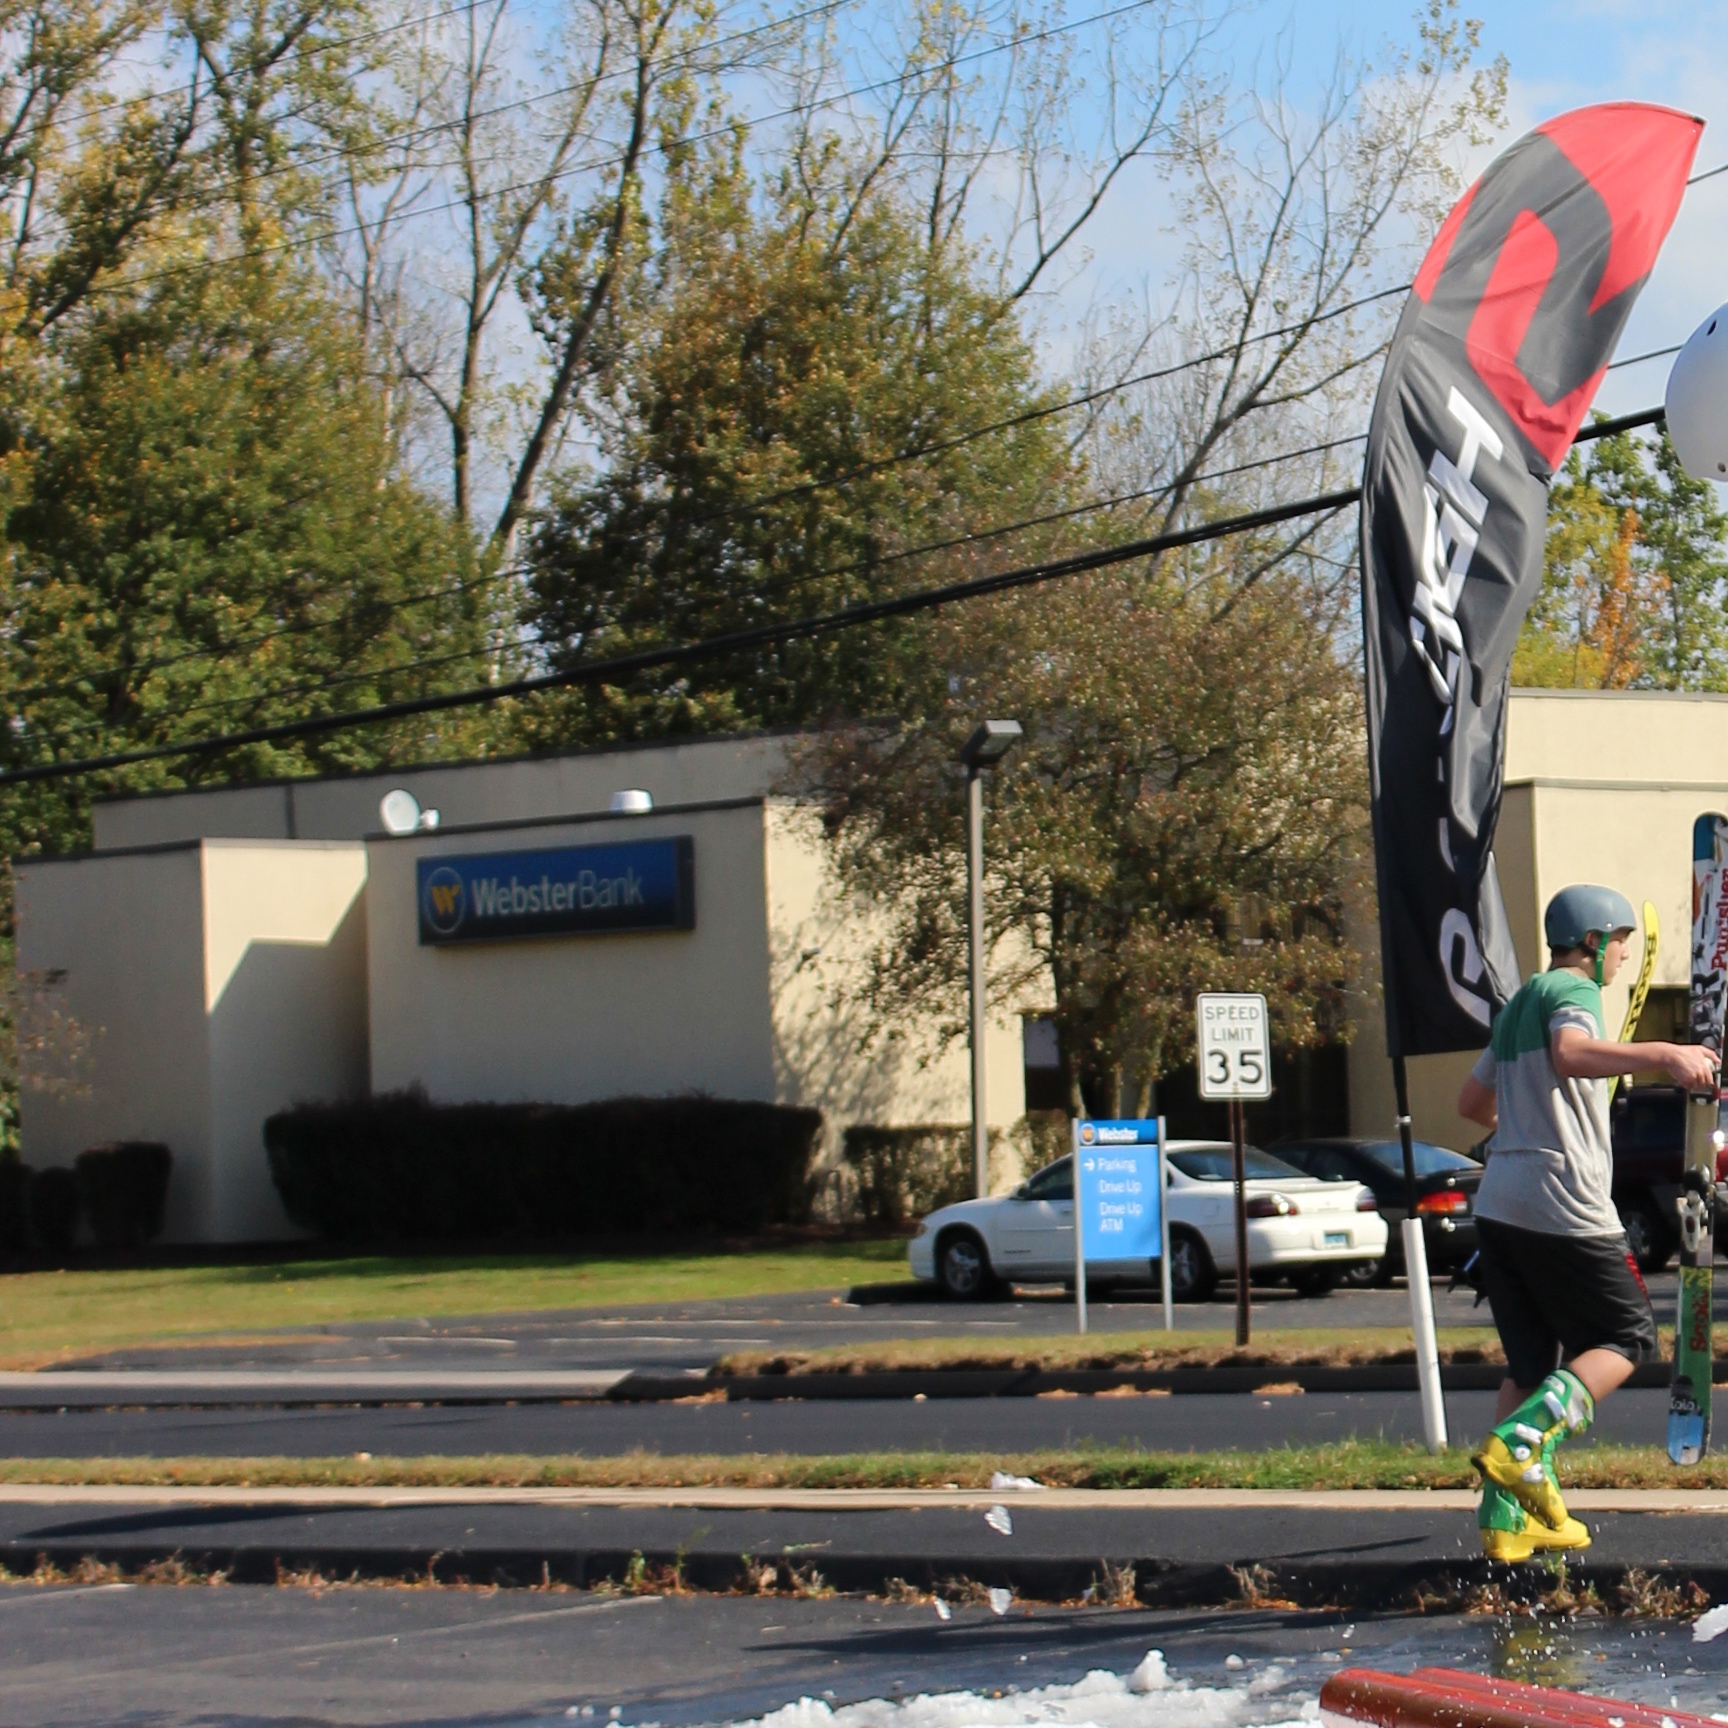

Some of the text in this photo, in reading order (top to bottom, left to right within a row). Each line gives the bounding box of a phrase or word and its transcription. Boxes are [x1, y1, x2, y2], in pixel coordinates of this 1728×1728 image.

[1205, 1006, 1260, 1020] SPEED
[1211, 1028, 1254, 1042] LIMIT
[1207, 1048, 1262, 1084] 35
[1098, 1127, 1139, 1141] Webster
[1098, 1158, 1137, 1173] Parking
[1100, 1179, 1142, 1194] Drive Up
[1100, 1202, 1143, 1217] Drive Up
[1100, 1218, 1124, 1231] ATM
